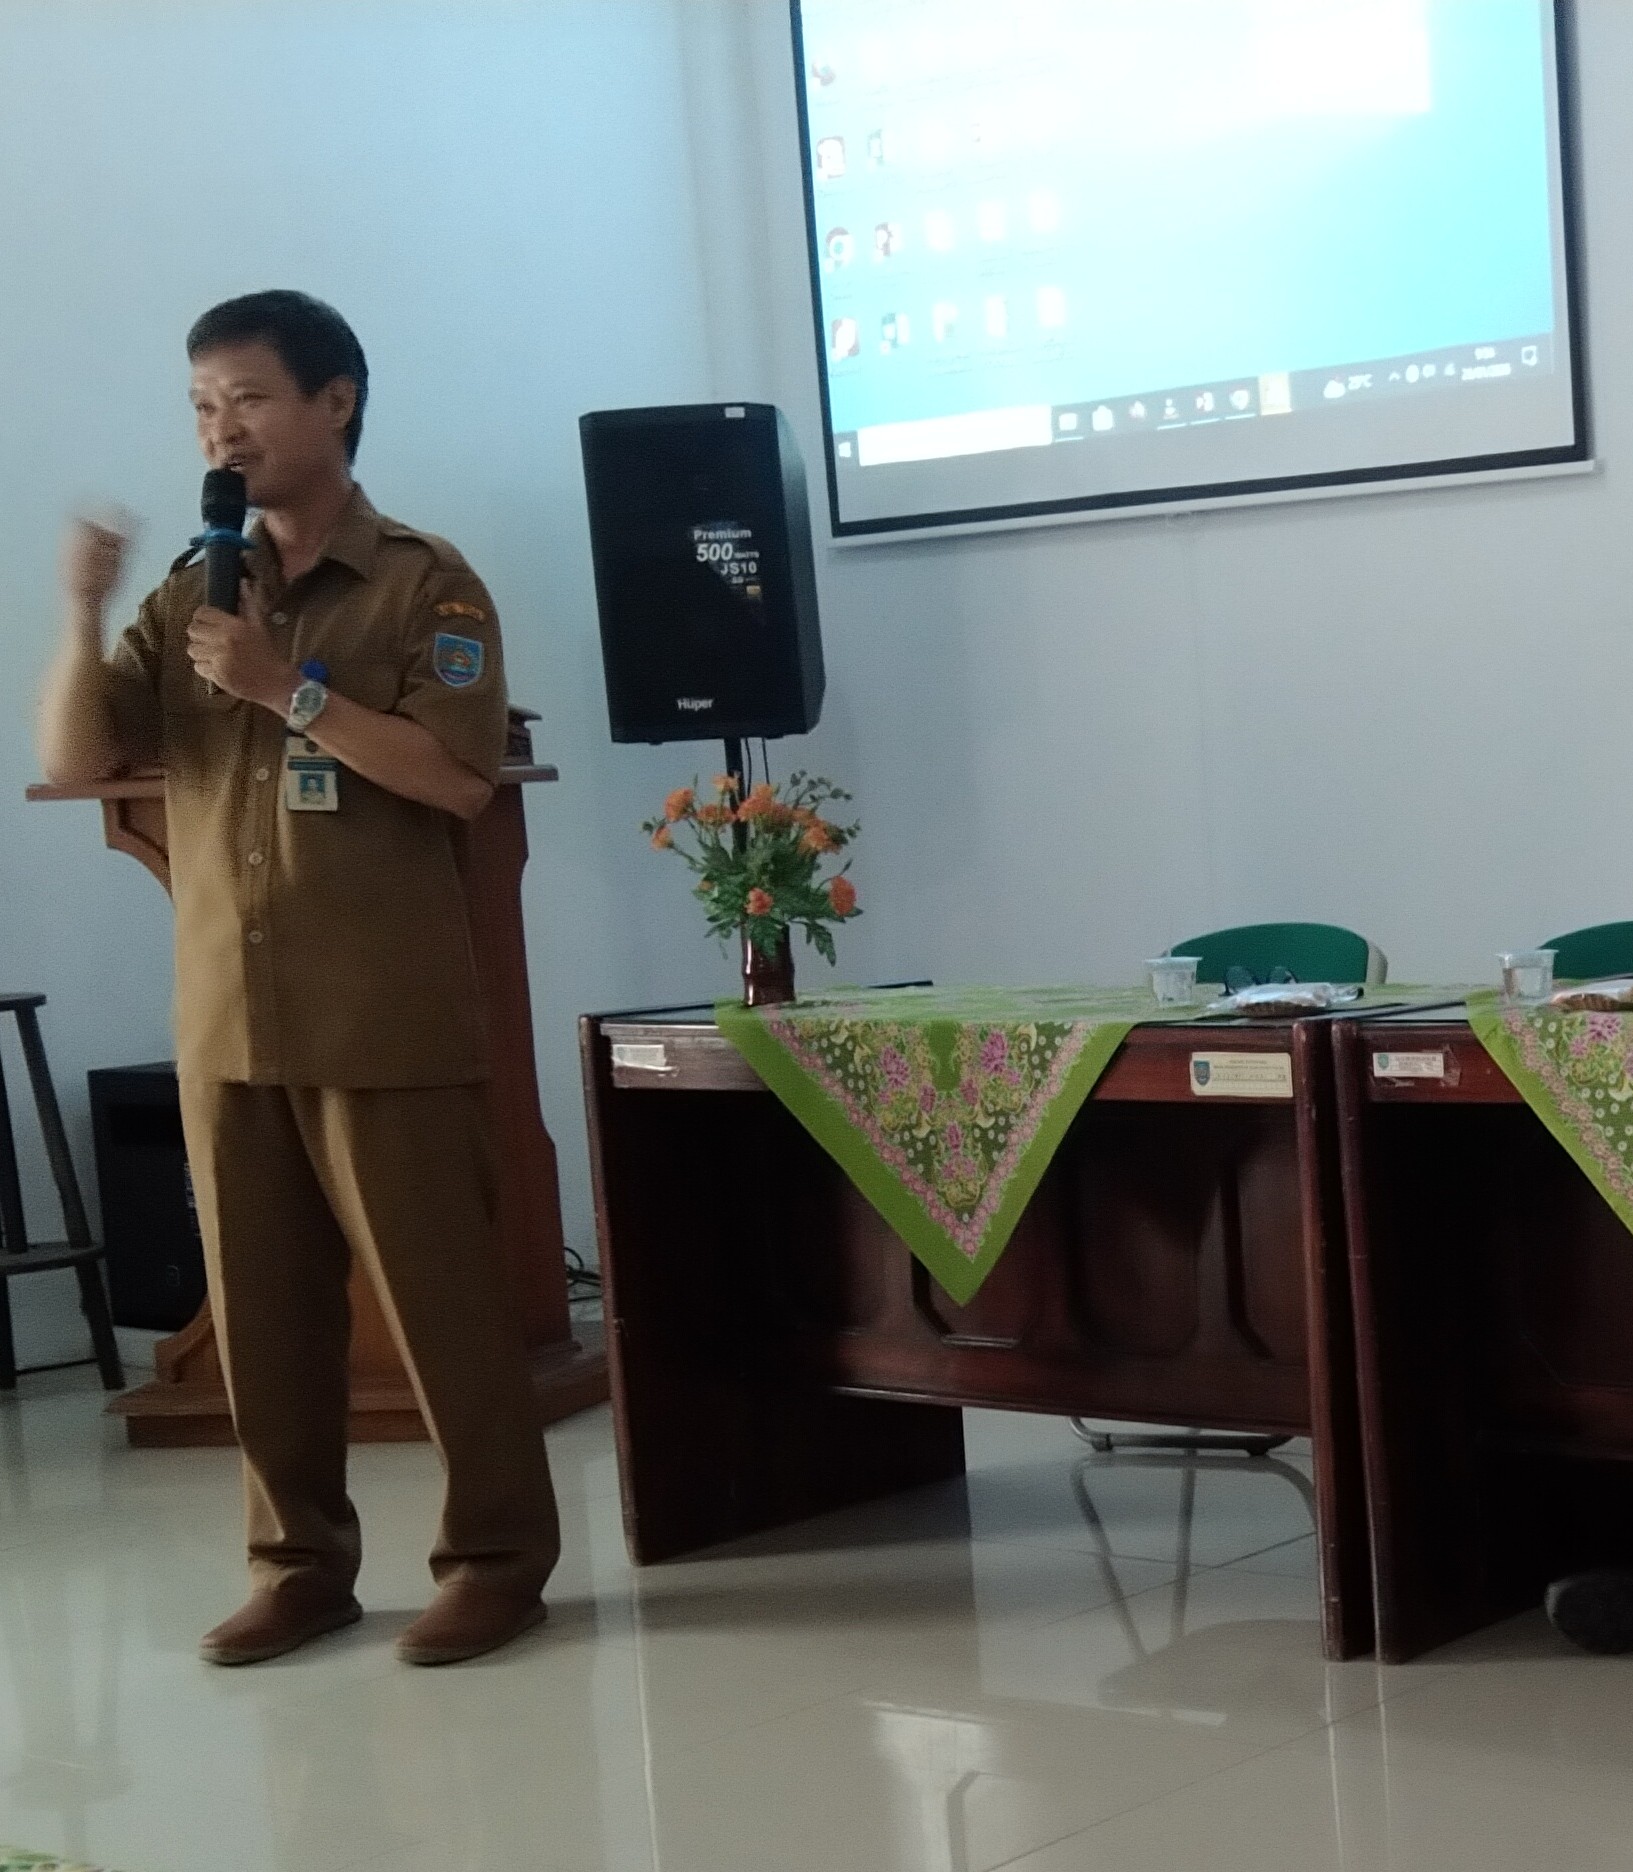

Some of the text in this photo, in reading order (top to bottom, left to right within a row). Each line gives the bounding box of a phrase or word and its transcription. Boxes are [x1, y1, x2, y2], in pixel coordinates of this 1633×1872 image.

[693, 529, 752, 540] Premium
[696, 542, 734, 562] 500
[720, 561, 758, 576] JS10
